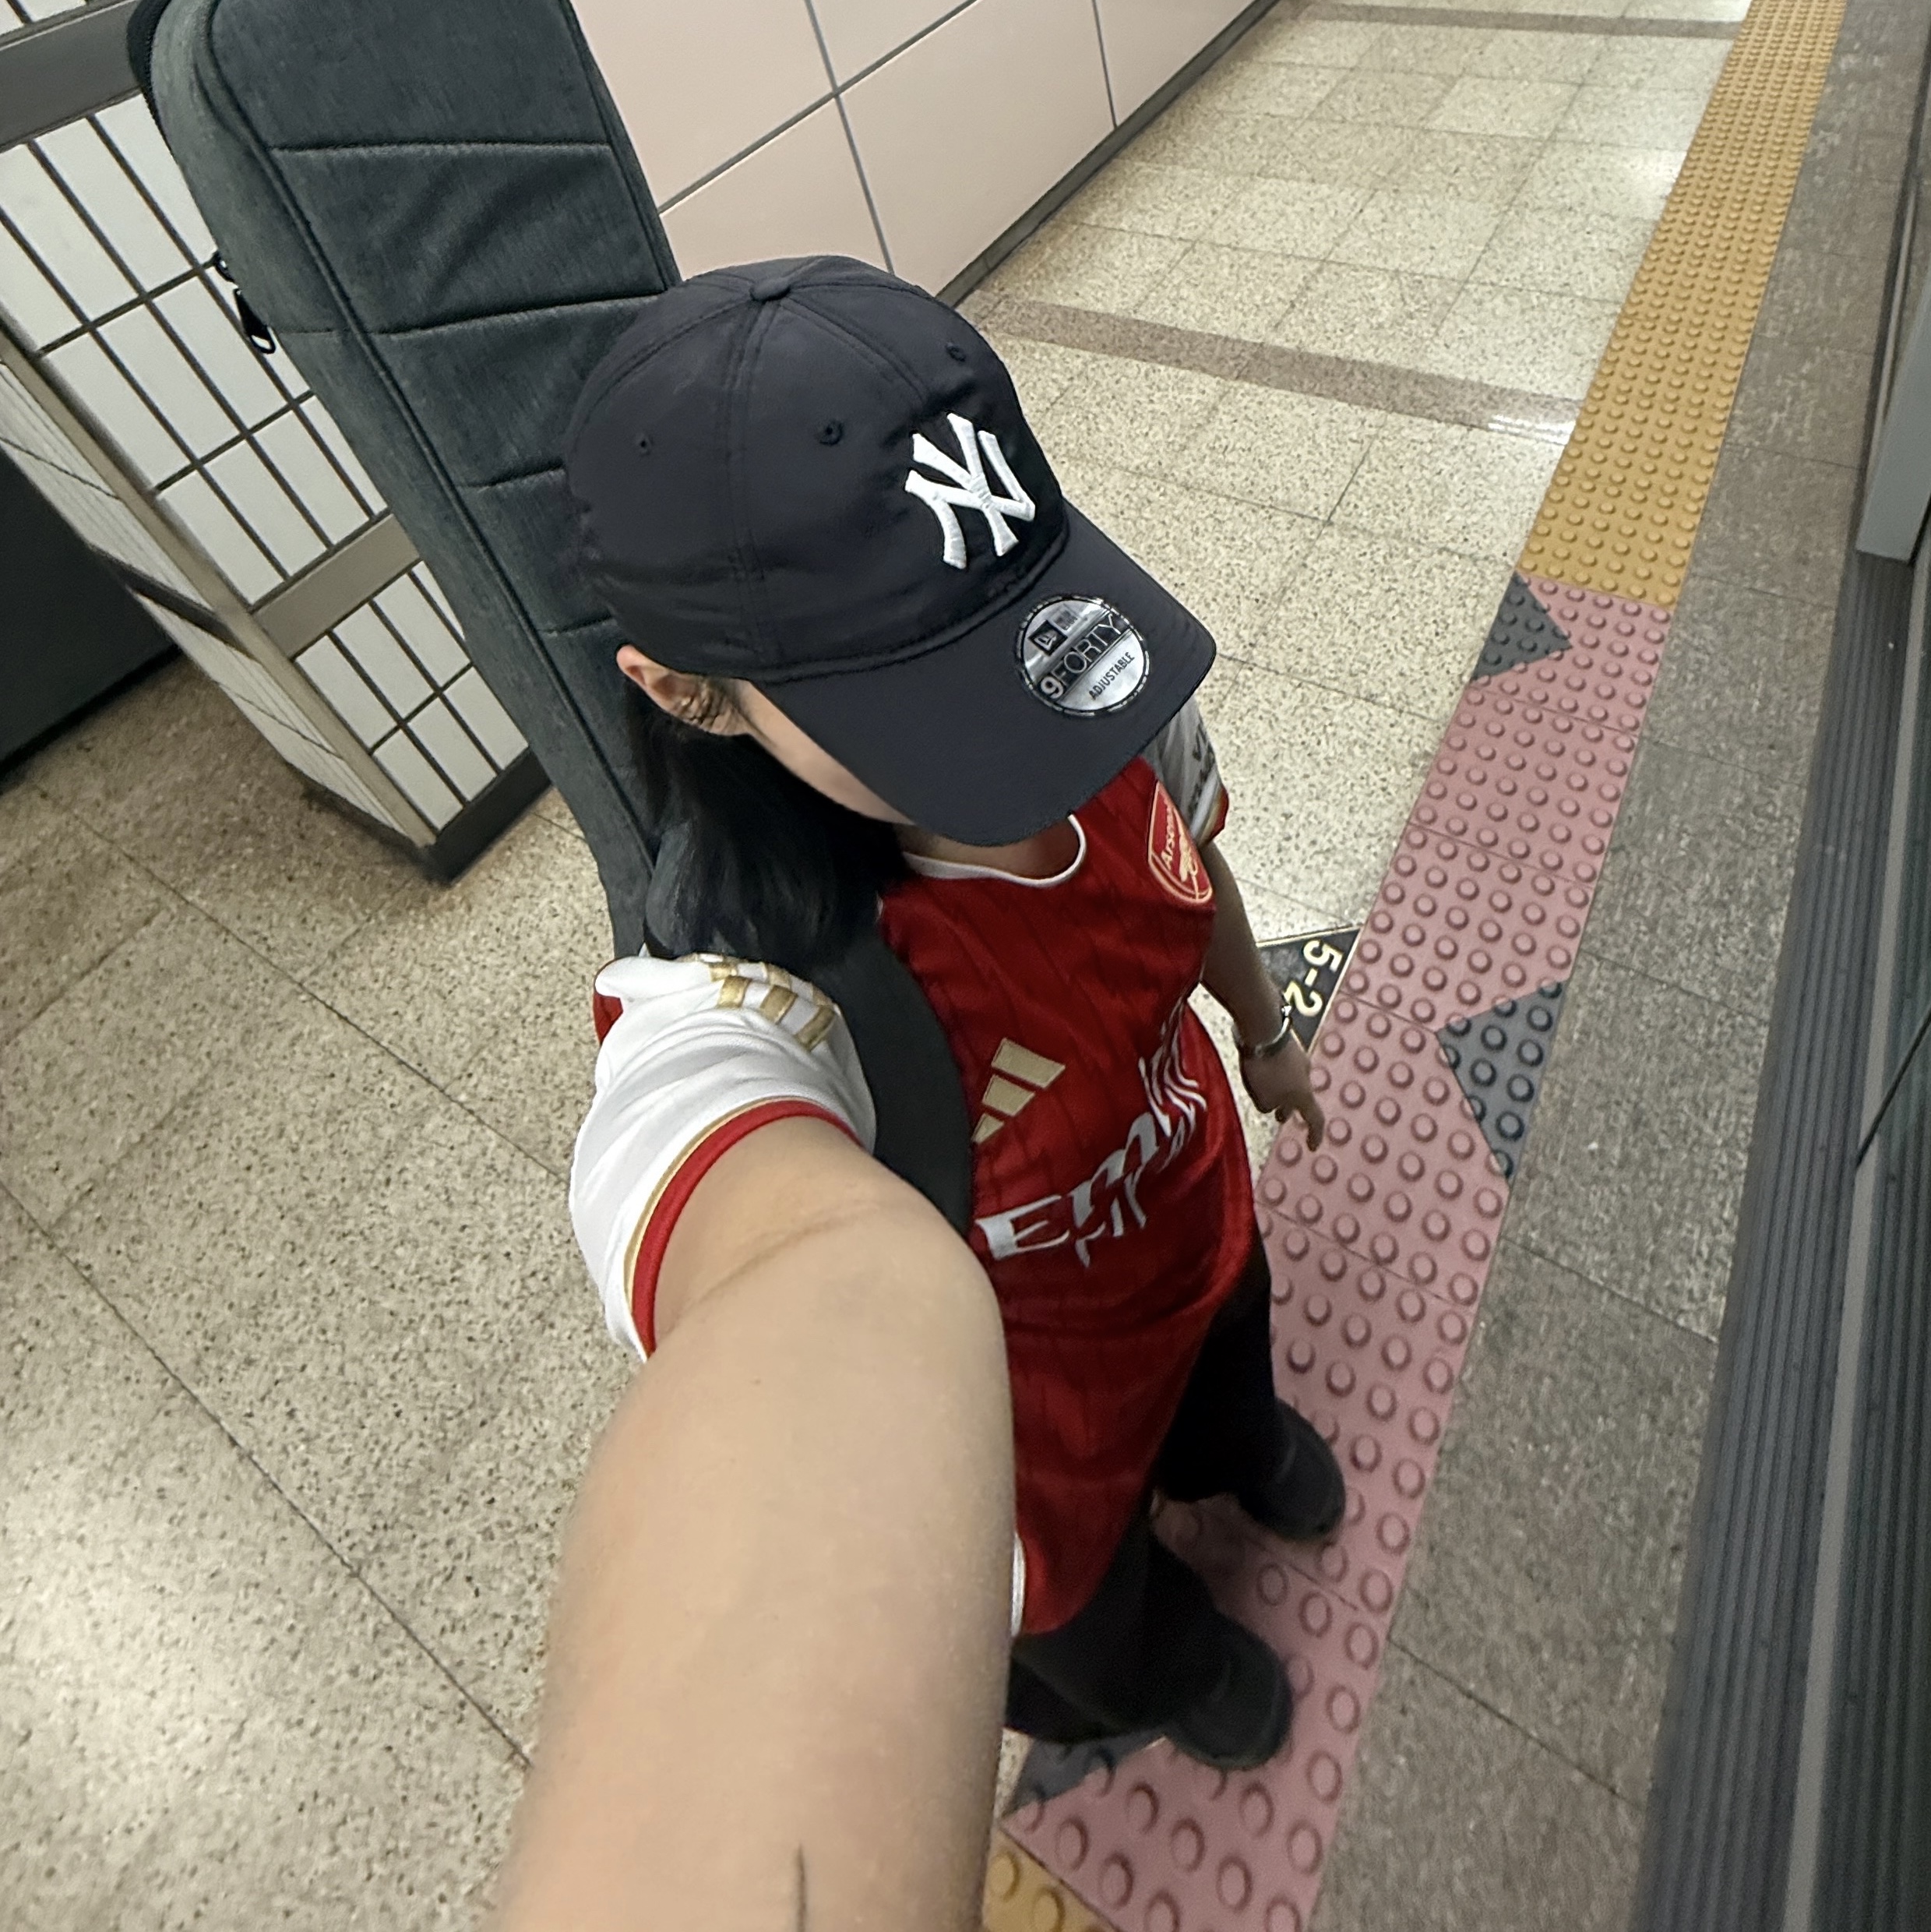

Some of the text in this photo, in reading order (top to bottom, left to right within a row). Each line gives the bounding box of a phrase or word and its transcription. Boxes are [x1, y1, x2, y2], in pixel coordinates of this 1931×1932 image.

[905, 412, 1036, 569] NY
[1040, 613, 1122, 699] 9FORTY
[1089, 651, 1135, 700] ADJUSTABLE
[1283, 940, 1344, 1017] 5-2
